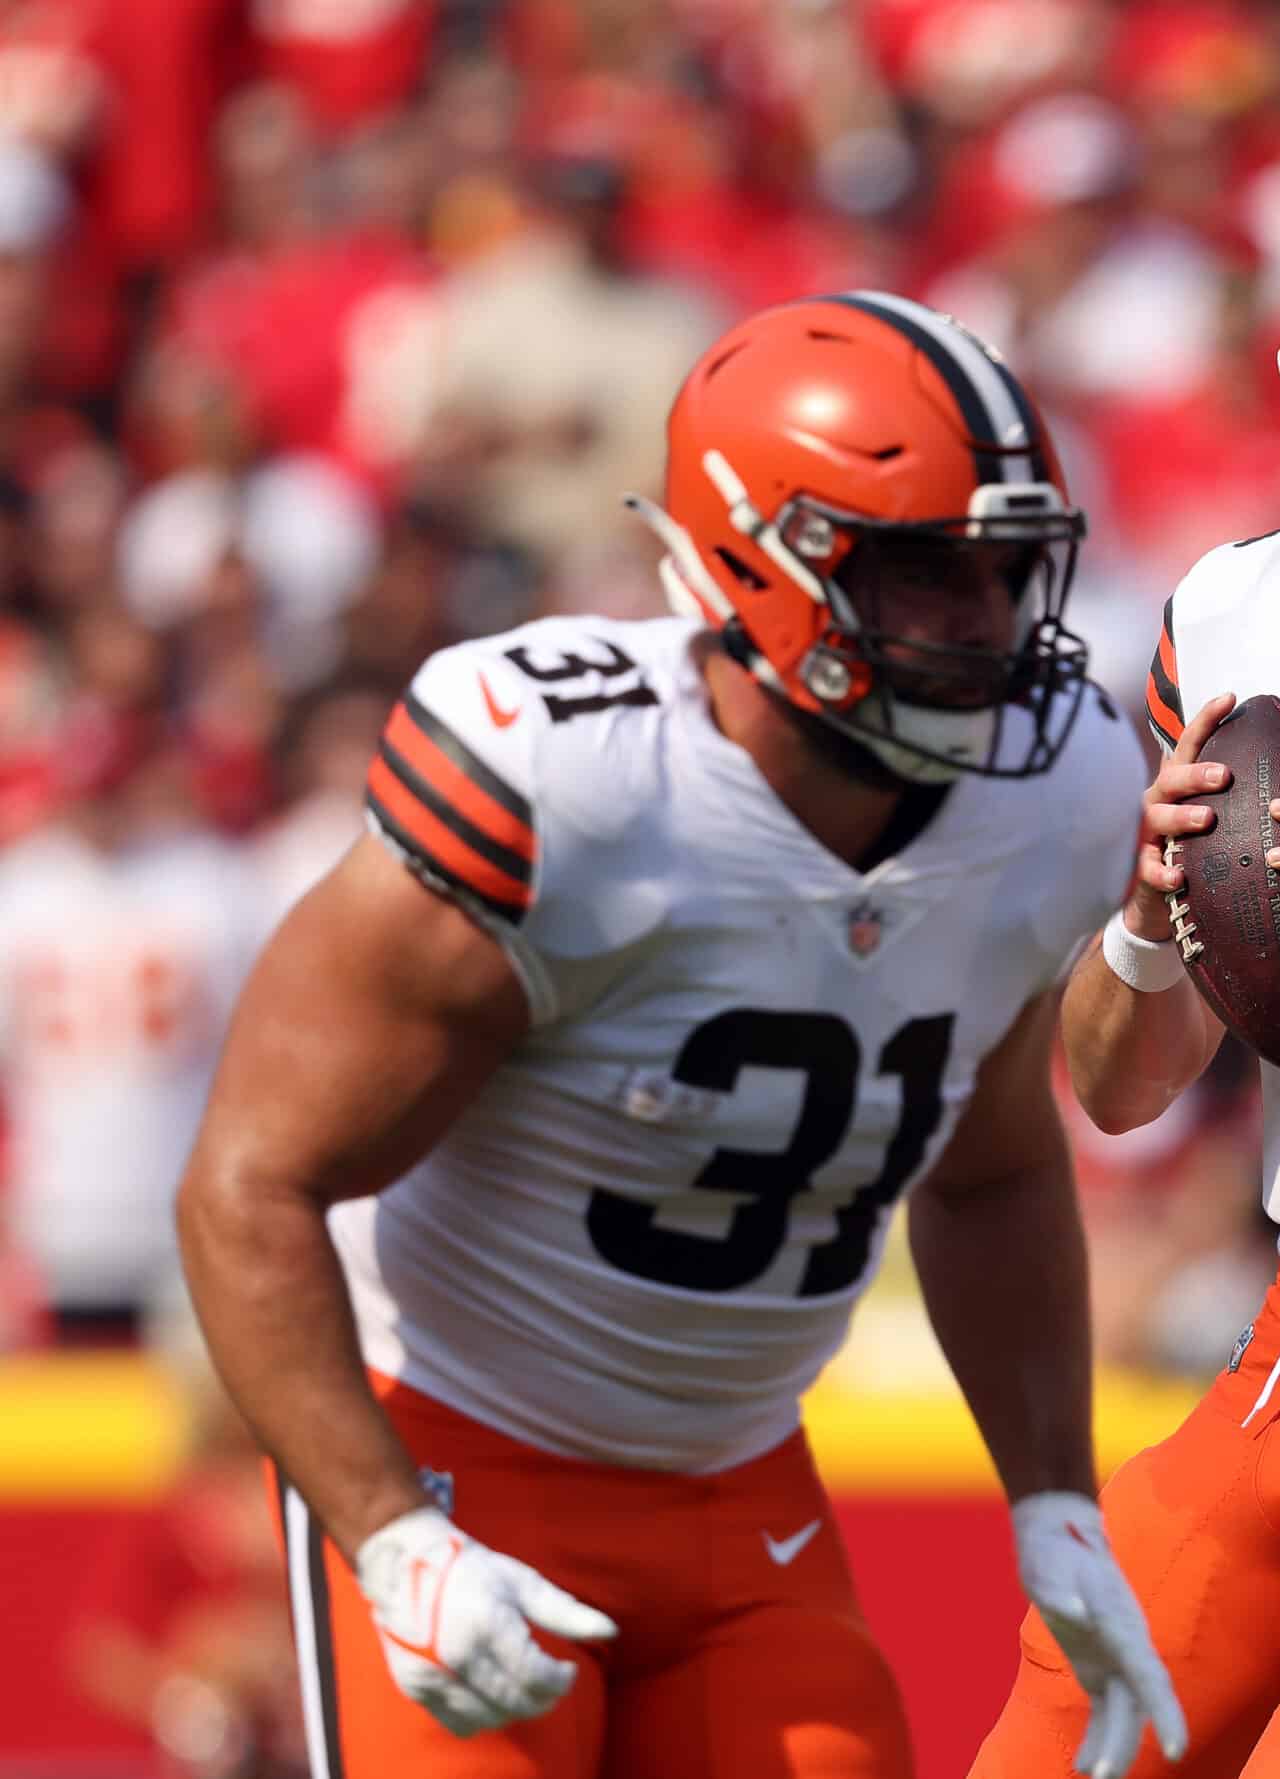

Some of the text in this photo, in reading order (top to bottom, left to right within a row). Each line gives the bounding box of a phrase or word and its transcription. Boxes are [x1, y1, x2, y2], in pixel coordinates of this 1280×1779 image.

[503, 634, 662, 724] 31
[1257, 756, 1273, 807] LEAGUE
[586, 1008, 956, 1298] 31
